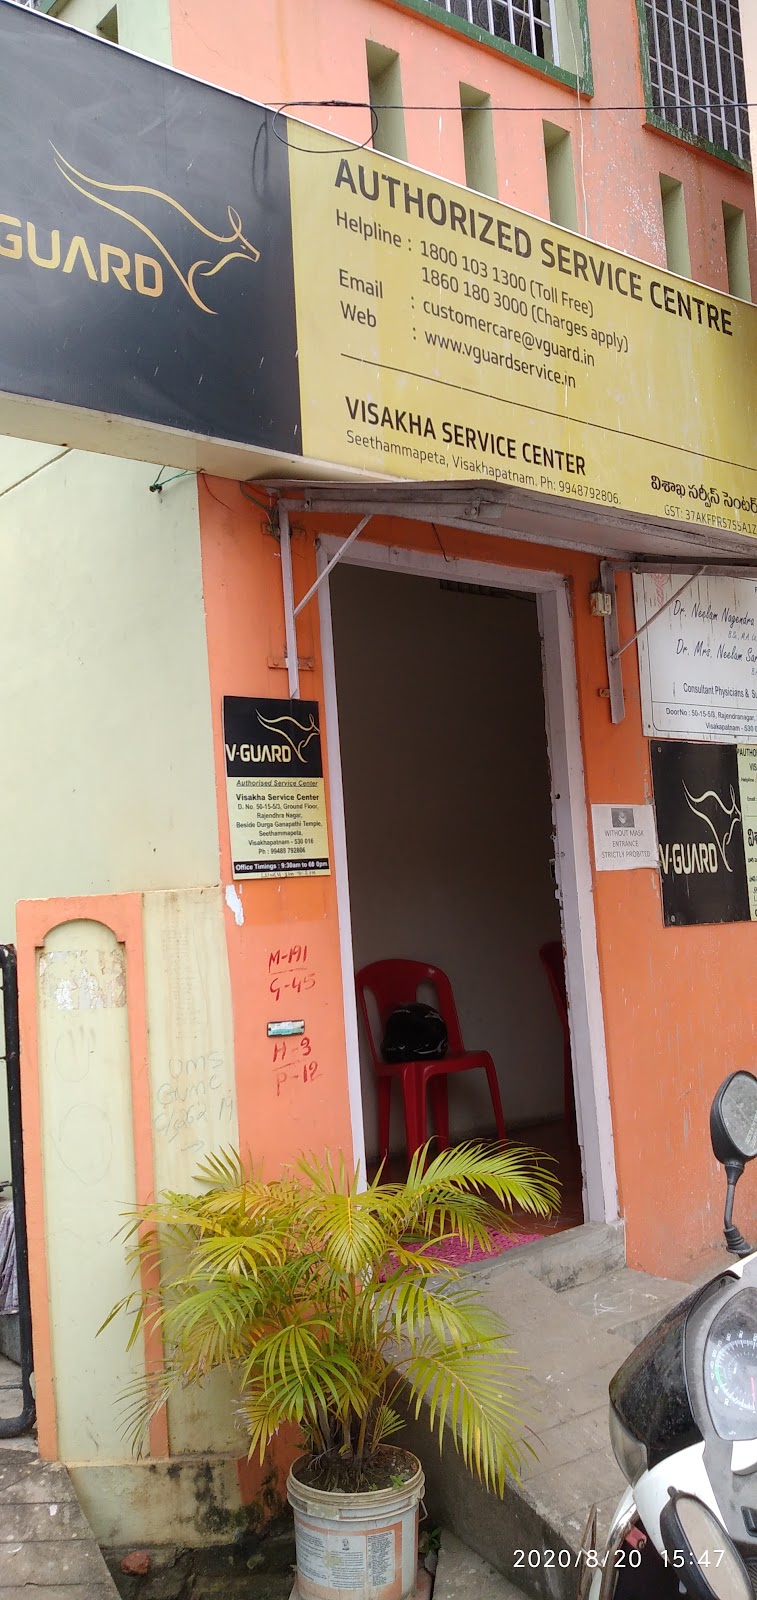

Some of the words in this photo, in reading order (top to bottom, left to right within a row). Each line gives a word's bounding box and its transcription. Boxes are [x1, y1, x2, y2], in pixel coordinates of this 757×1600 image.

[335, 158, 532, 259] AUTHORIZED
[541, 238, 643, 302] SERVICE
[650, 281, 733, 337] CENTRE
[336, 209, 402, 248] Helpline
[420, 240, 458, 267] 1800
[461, 255, 489, 277] 103
[492, 265, 527, 293] 1300
[530, 279, 558, 304] (Toll
[561, 290, 594, 318] Free)
[338, 268, 384, 299] Email
[423, 299, 595, 367] customercare@vguard.in
[422, 266, 459, 293] 1860
[463, 281, 490, 304] 180
[493, 292, 528, 317] 3000
[531, 304, 588, 340] (Charges
[590, 327, 629, 353] apply)
[340, 301, 377, 328] Web
[424, 329, 576, 388] www.vguardservice.in
[345, 396, 437, 440] VISAKHA
[442, 422, 516, 459] SERVICE
[522, 443, 586, 475] CENTER
[346, 430, 449, 467] Seethammapeta,
[452, 454, 538, 487] Visakhapatnam.
[540, 475, 556, 491] Ph:
[558, 481, 622, 505] 9948792806.
[651, 475, 686, 498] విశాఖ
[688, 484, 720, 508] సర్వీస్
[664, 504, 684, 518] GST:
[673, 600, 687, 617] Dr.
[691, 603, 718, 621] Neelam
[721, 607, 755, 629] Nagendra
[676, 638, 690, 656] Dr.
[694, 640, 713, 659] Mrs.
[717, 643, 743, 661] Neelam
[683, 682, 714, 695] Consultant
[715, 686, 744, 699] Physicians
[745, 689, 749, 698] &
[718, 711, 756, 722] Rajendranagar,
[225, 743, 292, 763] V-GUARD
[236, 779, 272, 787] Authorised
[273, 779, 298, 787] Service
[299, 779, 318, 787] Center
[236, 793, 266, 801] Visakha
[267, 793, 295, 801] Service
[296, 793, 319, 801] Center
[236, 821, 256, 829] Beside
[257, 821, 274, 829] Durga
[274, 820, 302, 829] Ganapathi
[303, 820, 323, 828] Temple,
[257, 812, 285, 820] Rajendhra
[286, 812, 303, 820] Nagar,
[258, 830, 303, 838] Seethammapeta,
[604, 829, 629, 837] WITHOUT
[629, 829, 644, 837] MASK
[254, 863, 277, 871] Timings
[659, 843, 718, 875] V-GUARD
[268, 944, 308, 973] M-191
